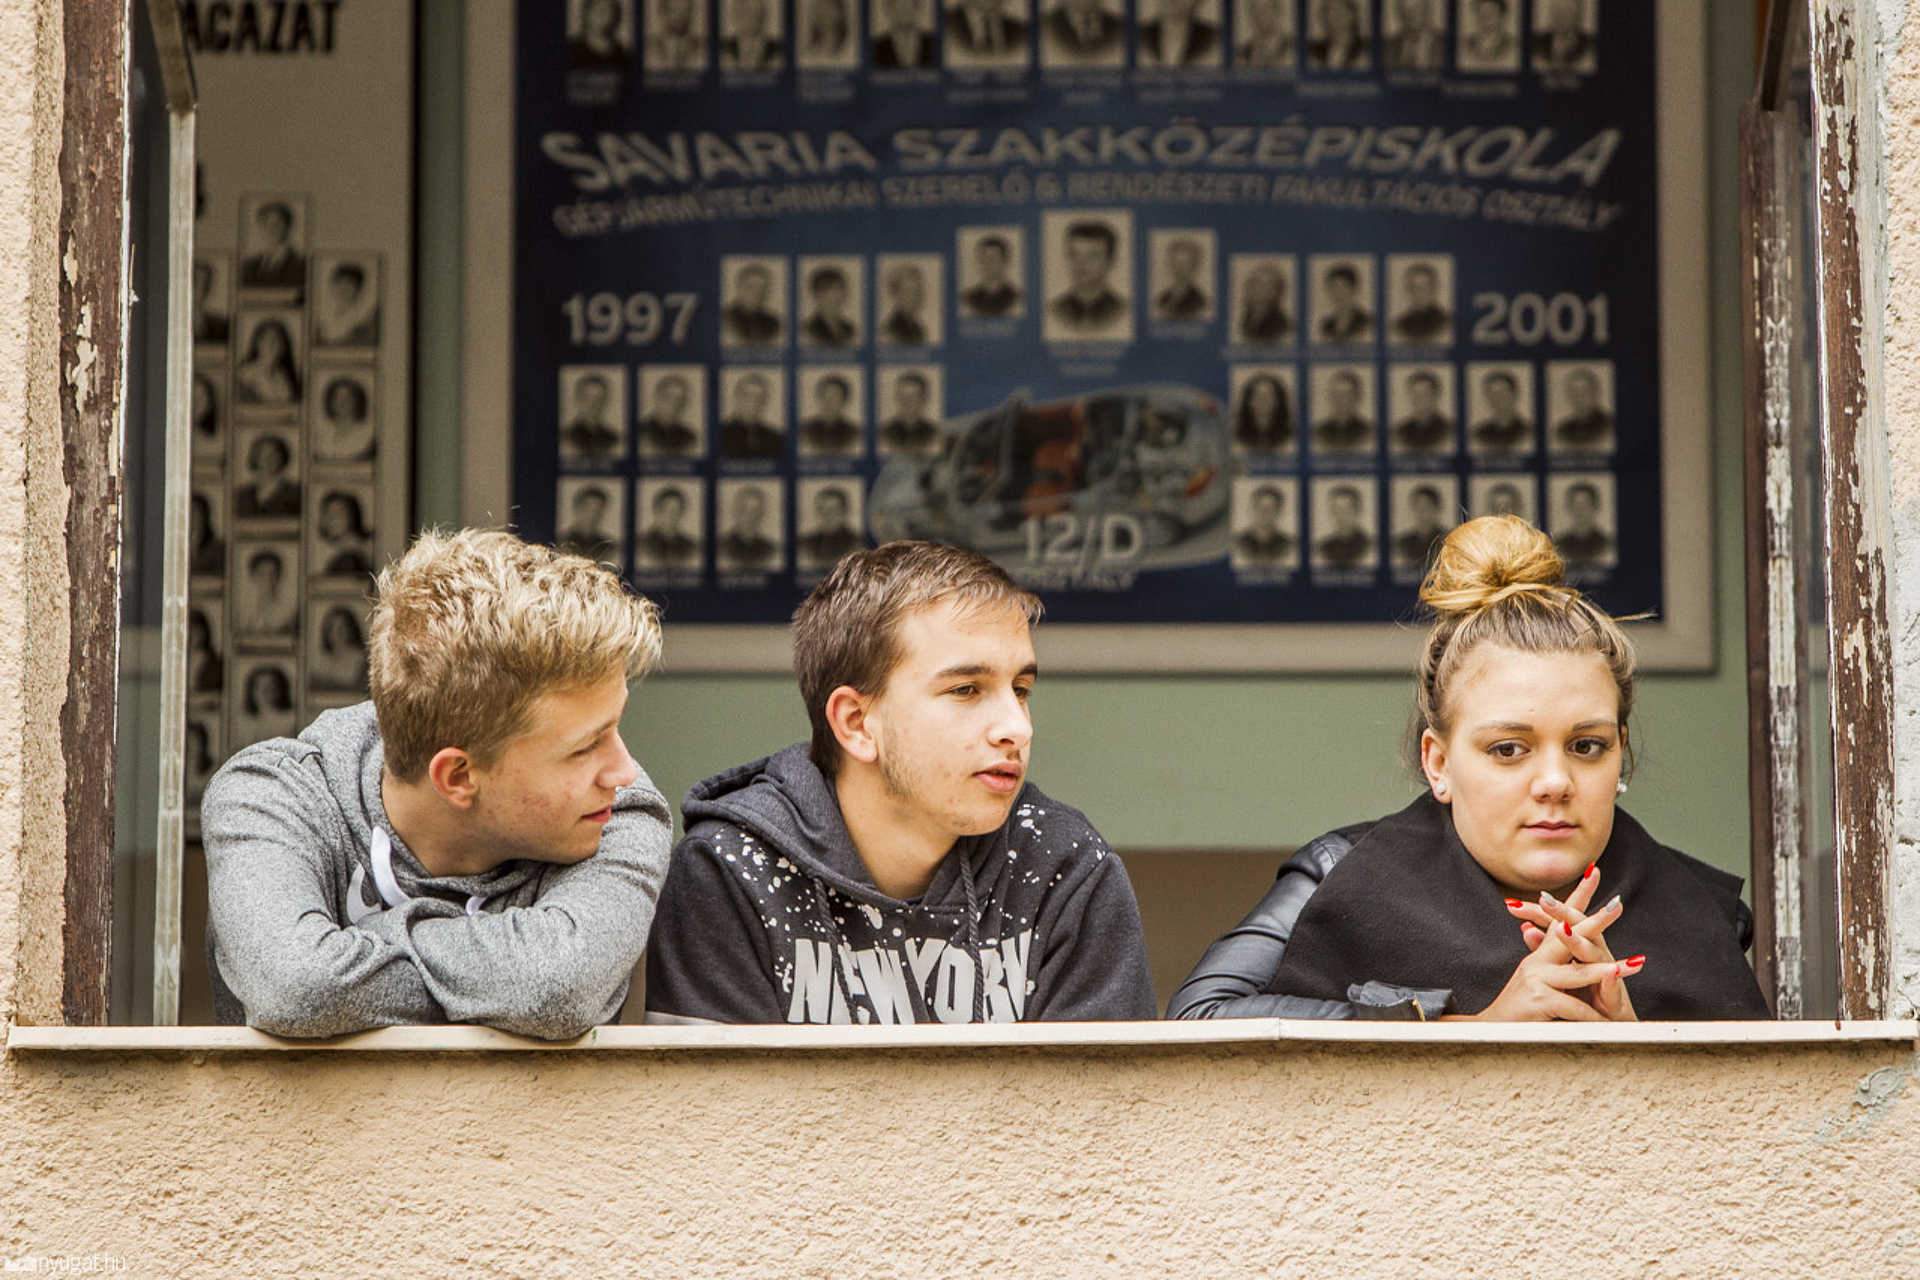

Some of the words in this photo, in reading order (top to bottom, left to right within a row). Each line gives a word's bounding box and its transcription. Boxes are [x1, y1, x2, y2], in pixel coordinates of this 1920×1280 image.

[541, 130, 877, 191] SAVARIA
[890, 113, 1622, 186] SZAKKÖZÉPISKOLA
[561, 290, 698, 345] 1997
[1471, 290, 1611, 345] 2001
[1021, 512, 1143, 568] 12/D
